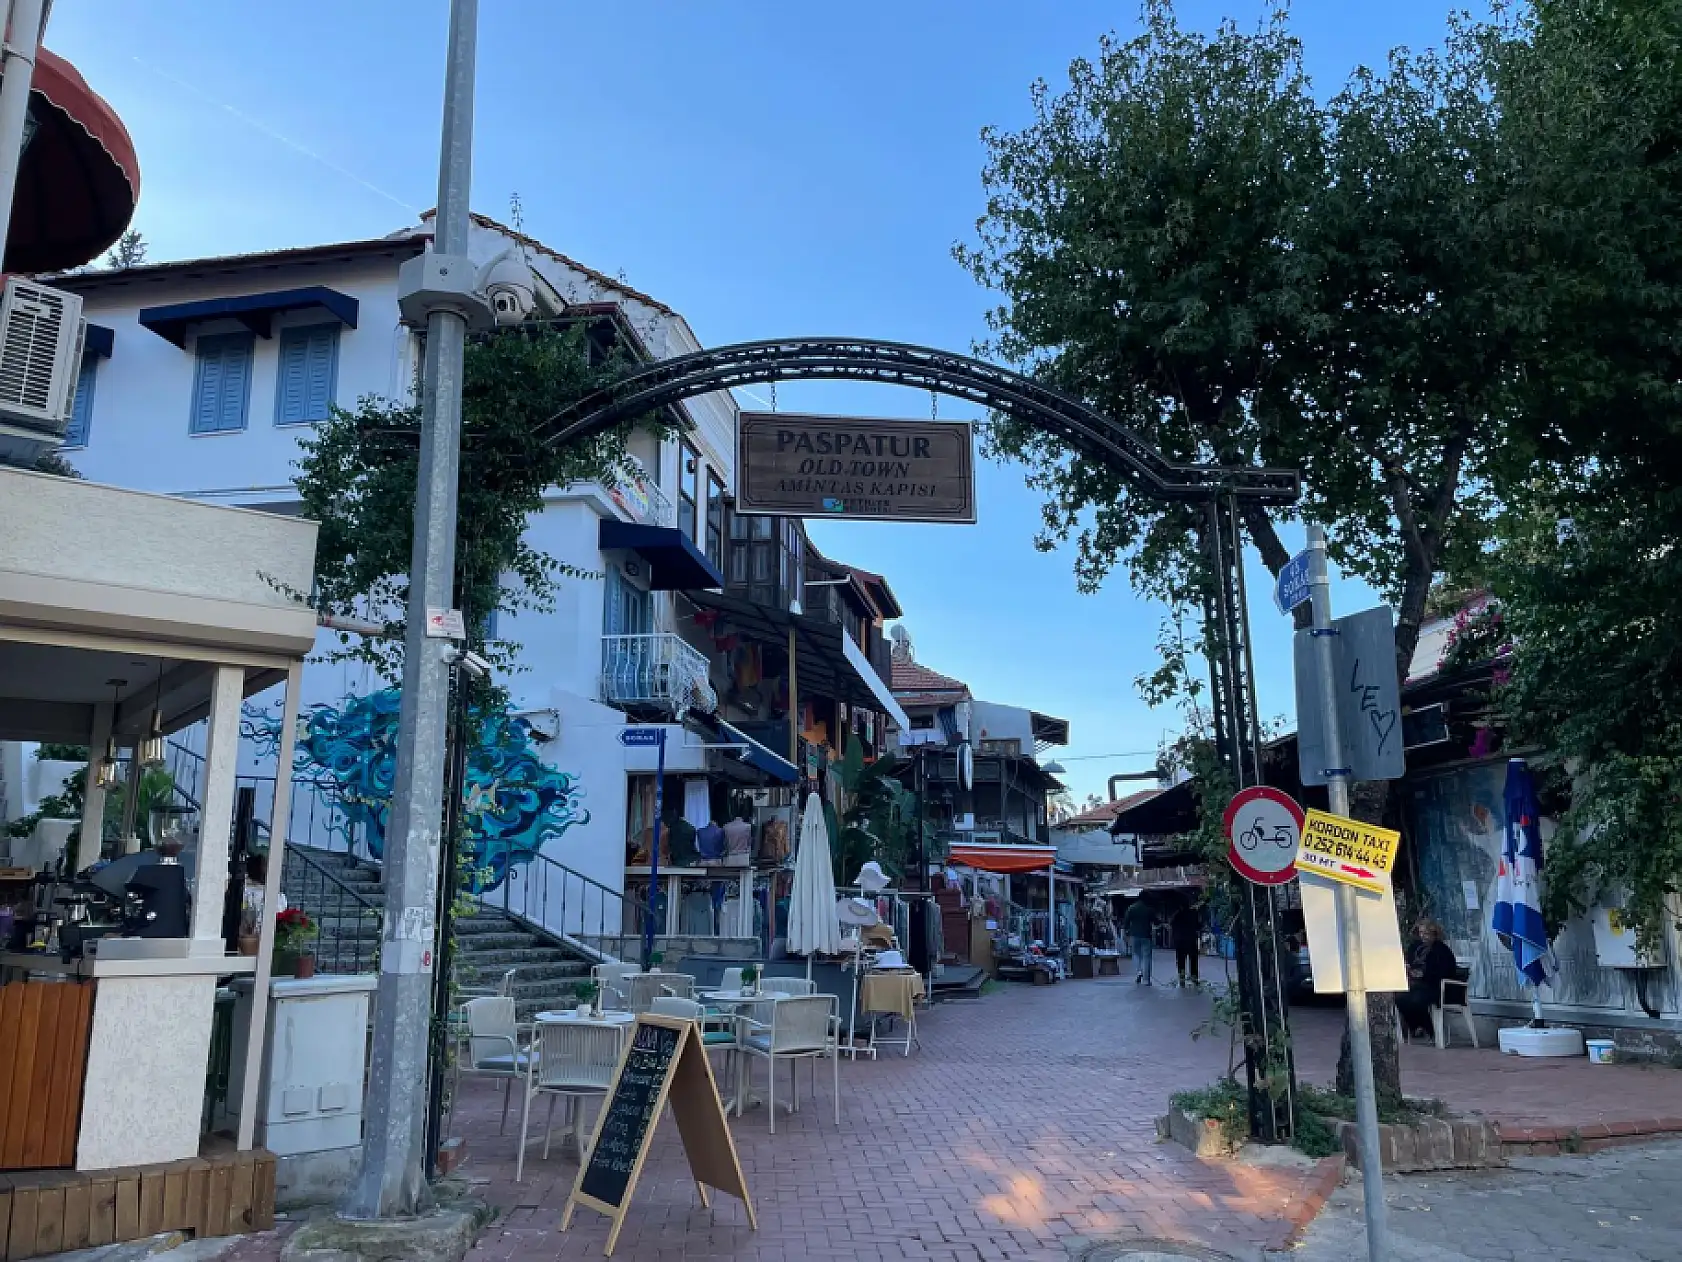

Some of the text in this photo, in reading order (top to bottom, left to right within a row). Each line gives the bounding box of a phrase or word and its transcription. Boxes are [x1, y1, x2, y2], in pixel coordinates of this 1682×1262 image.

[777, 429, 931, 458] PASPATUR
[798, 458, 910, 478] OLD TOWN
[1304, 833, 1313, 847] 0
[1313, 836, 1335, 854] 252
[1308, 818, 1391, 852] KORDON TAXI
